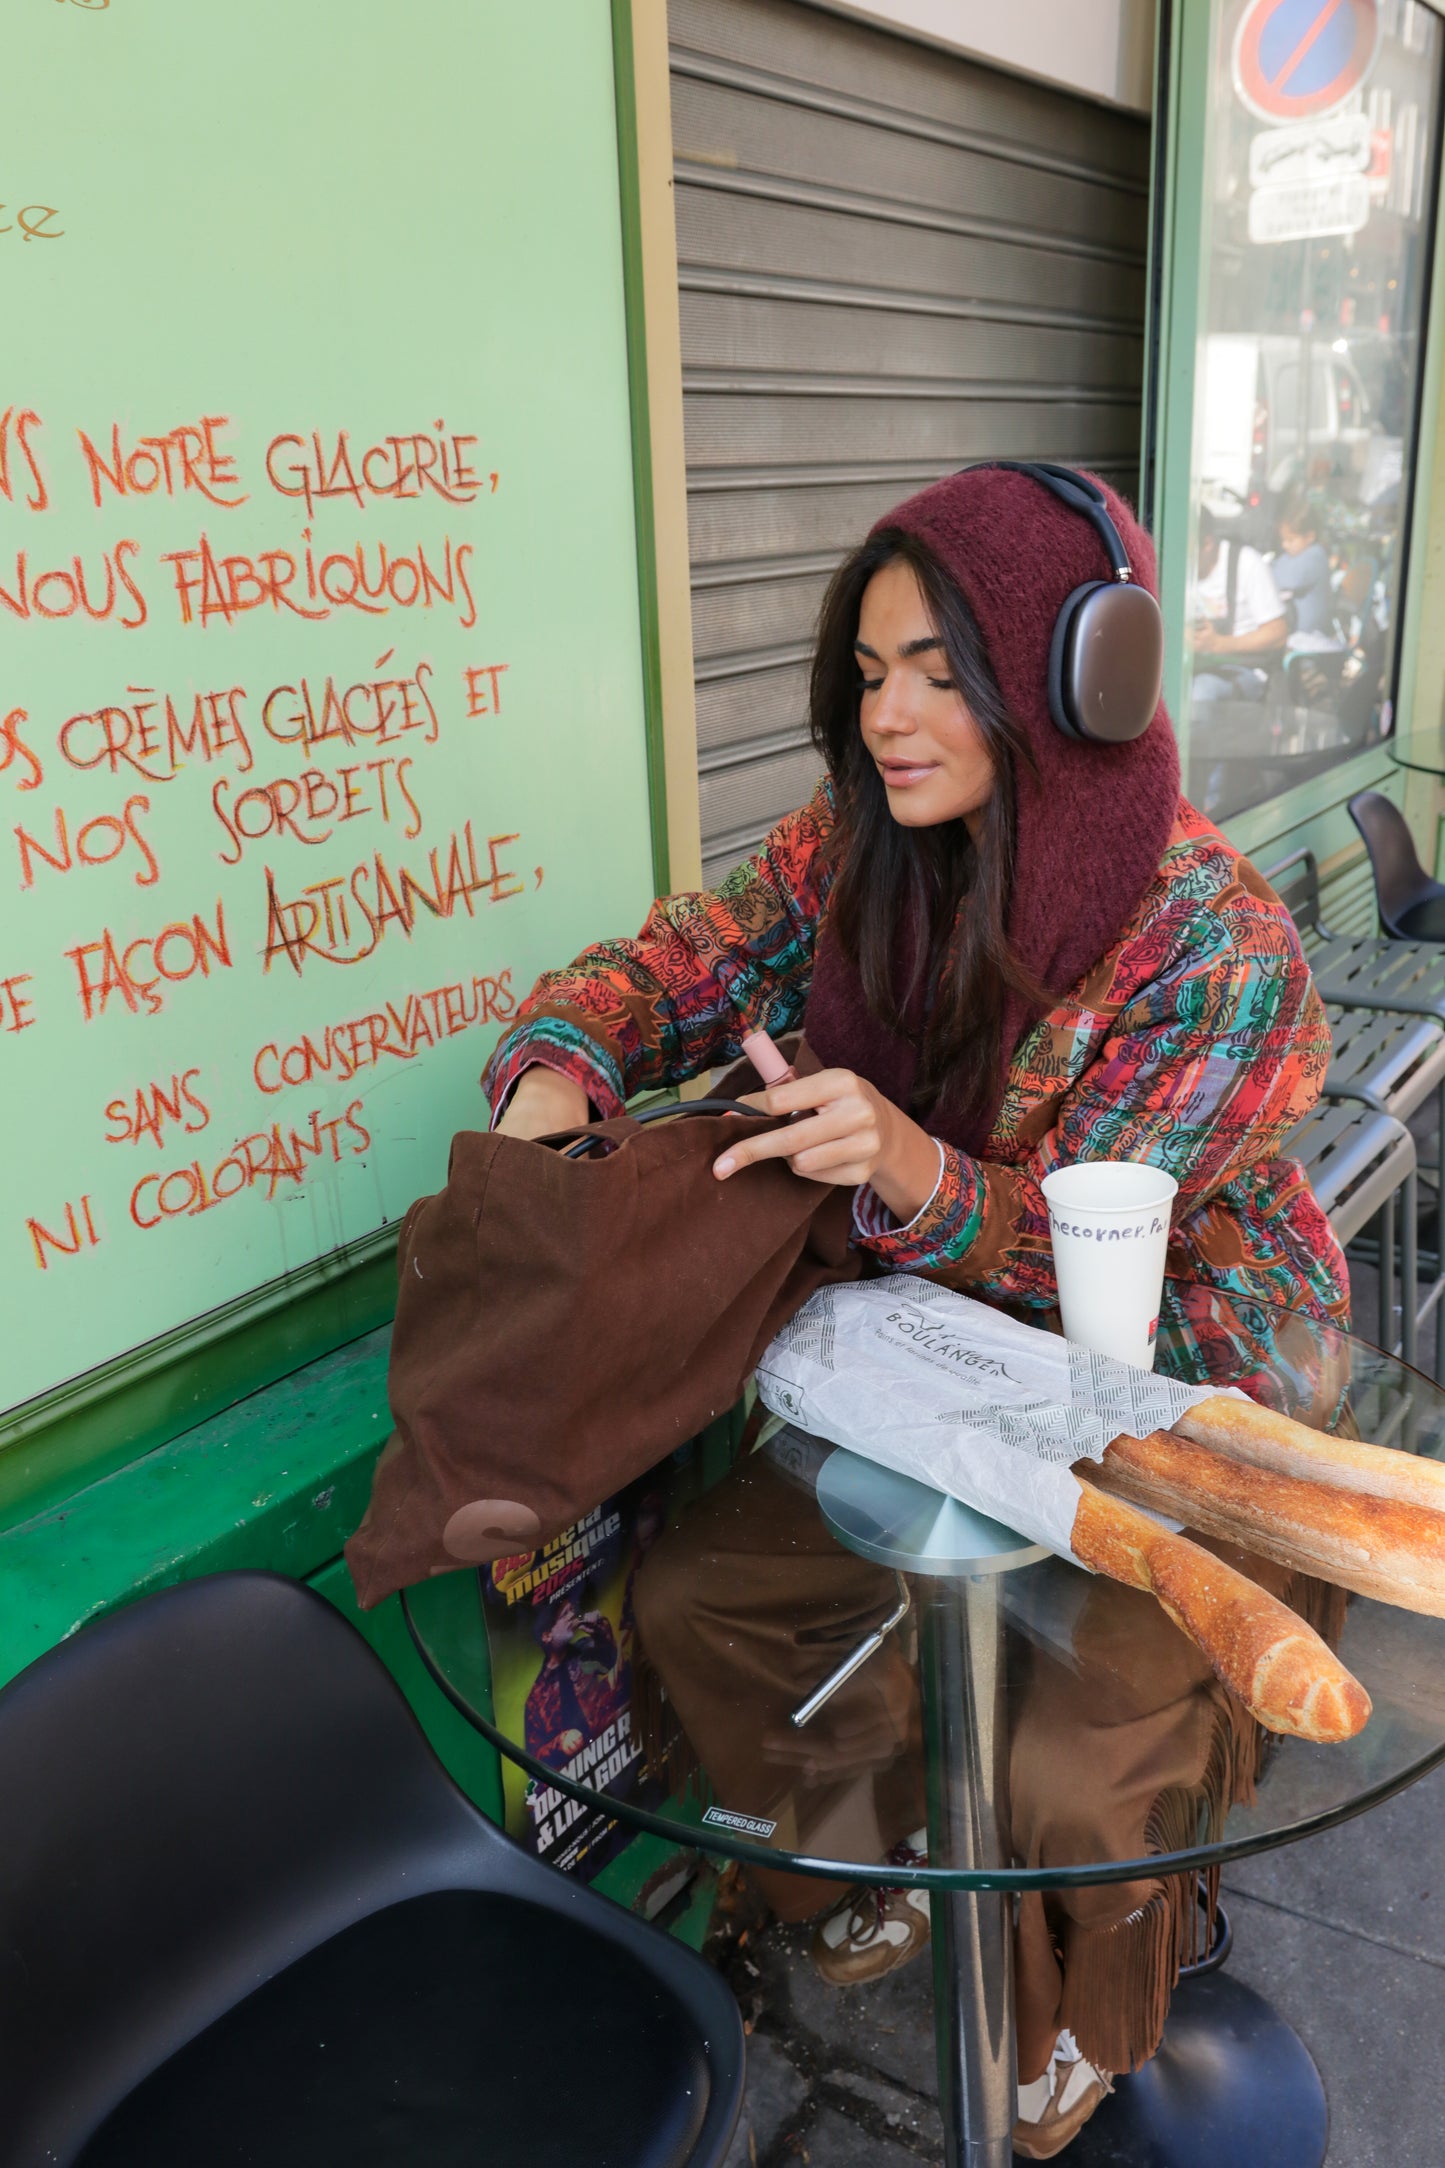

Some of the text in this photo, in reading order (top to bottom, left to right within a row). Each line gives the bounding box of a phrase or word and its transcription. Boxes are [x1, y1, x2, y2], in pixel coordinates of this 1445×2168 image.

[0, 205, 65, 242] e
[77, 416, 251, 508] NOTRE
[266, 419, 499, 520] GLACERIE,
[160, 527, 477, 629] FABRIQUONS
[262, 649, 438, 758] GLACÉES
[465, 664, 510, 718] ET
[14, 758, 422, 891] NOS SORBETS
[0, 820, 544, 1034] E FAÇON ARTISANALE,
[105, 968, 521, 1149] SANS CONSERVATEURS
[25, 1100, 372, 1270] NI COLORANTS
[507, 1512, 621, 1607] musique
[708, 1811, 772, 1834] TEMPERED GLASS
